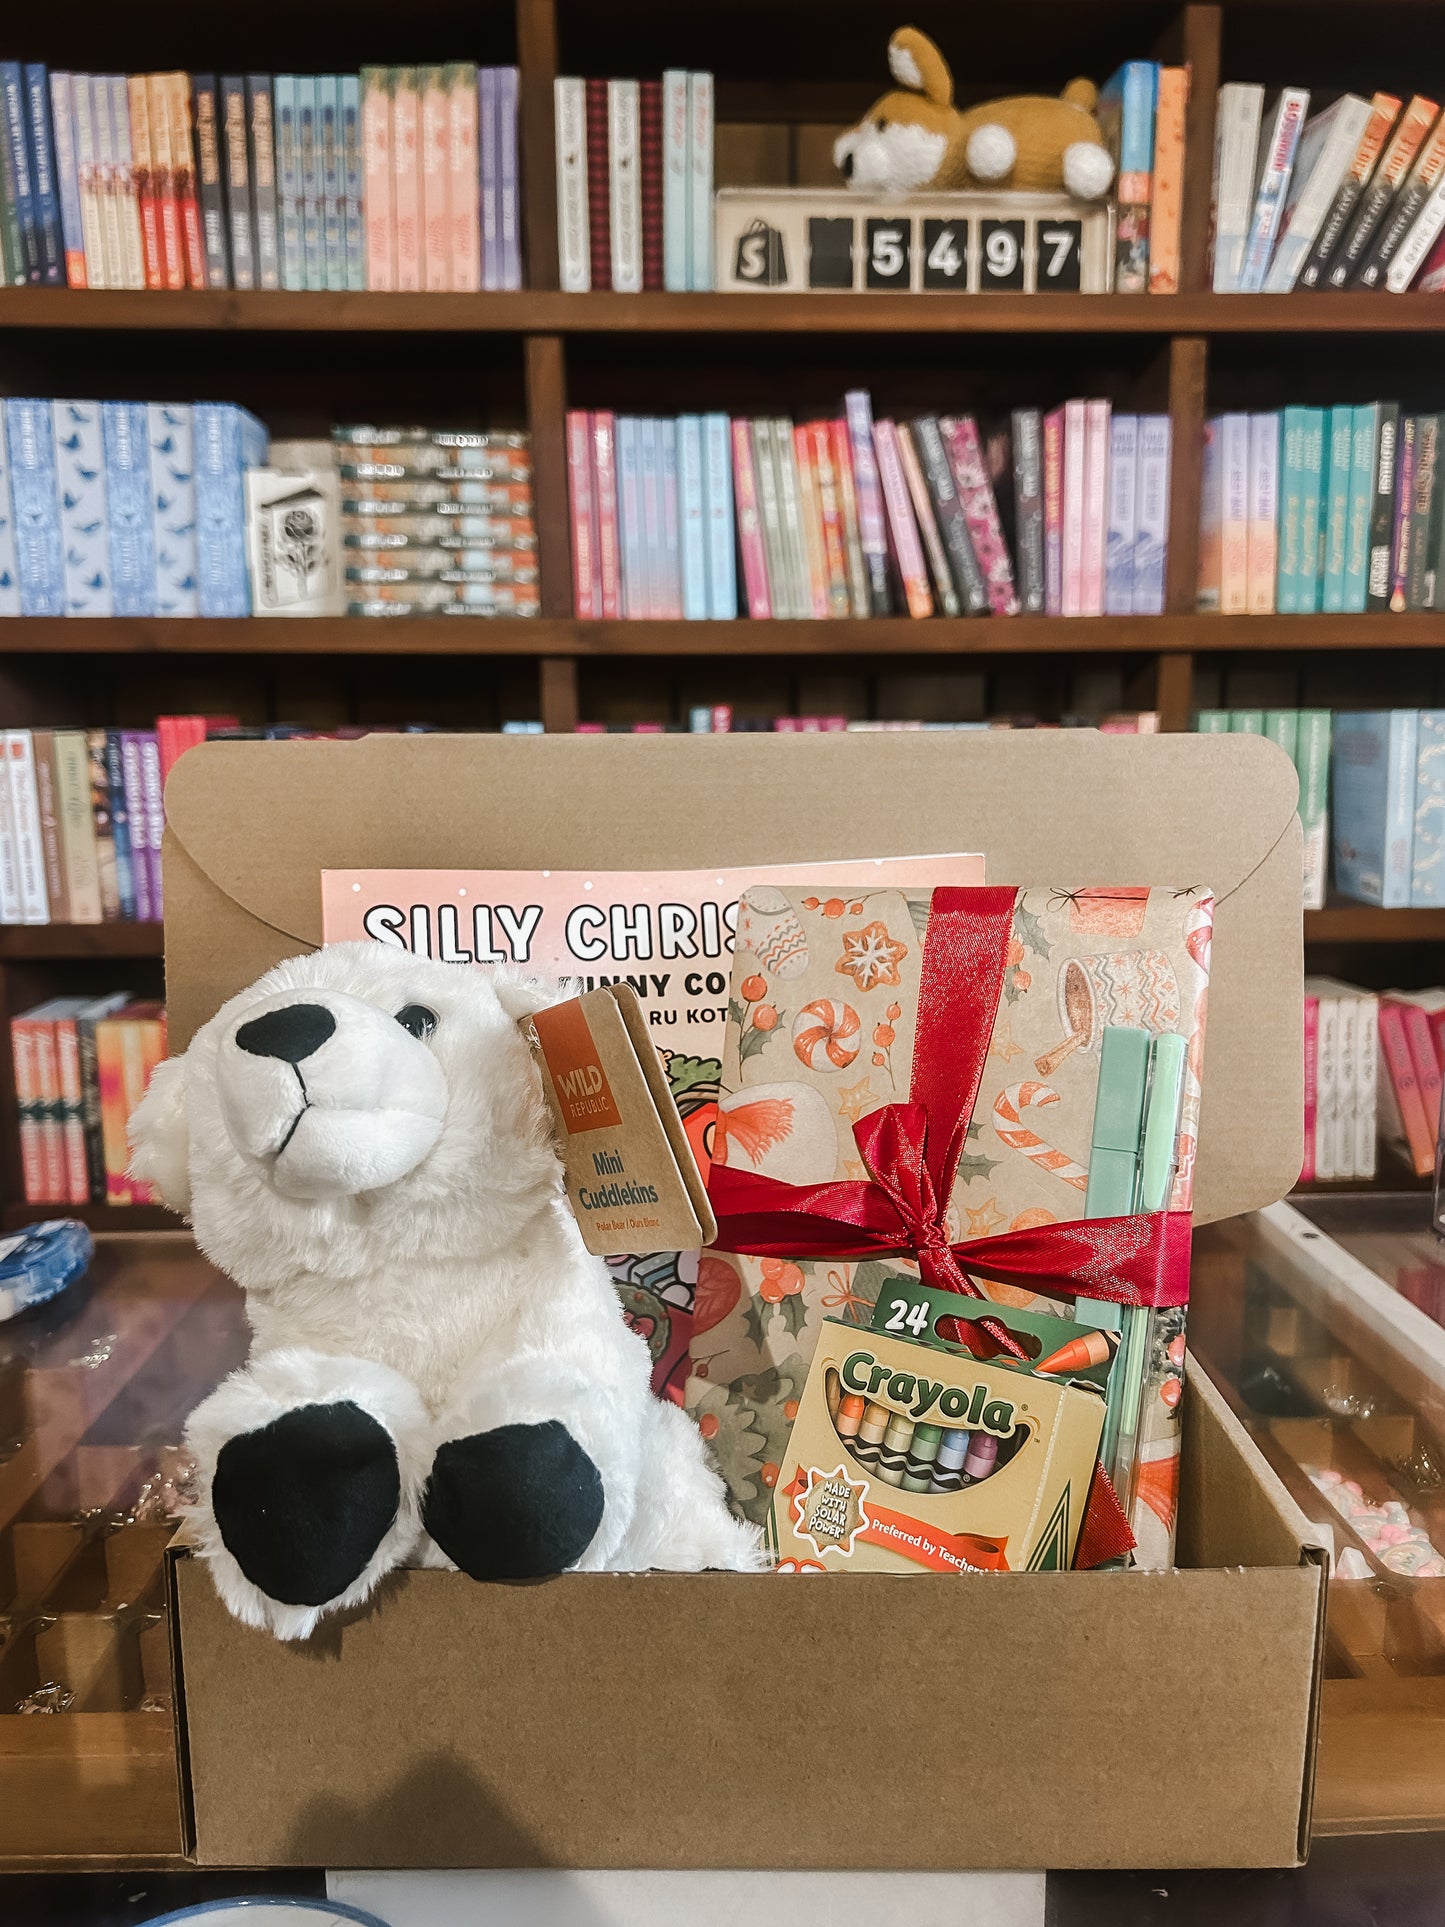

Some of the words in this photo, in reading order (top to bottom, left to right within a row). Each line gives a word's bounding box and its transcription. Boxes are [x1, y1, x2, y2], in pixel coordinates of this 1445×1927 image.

[363, 904, 544, 964] SILLY
[684, 971, 733, 997] CO
[557, 1065, 603, 1100] WILD
[570, 1096, 610, 1118] REPUBLIC
[592, 1149, 625, 1176] Mini
[579, 1180, 659, 1210] Cuddlekins
[885, 1299, 930, 1335] 24
[842, 1351, 1014, 1433] Crayola
[820, 1495, 846, 1513] WITH
[824, 1481, 851, 1499] MADE
[814, 1504, 847, 1527] SOLAR
[872, 1518, 922, 1548] Preferred
[922, 1537, 937, 1556] by
